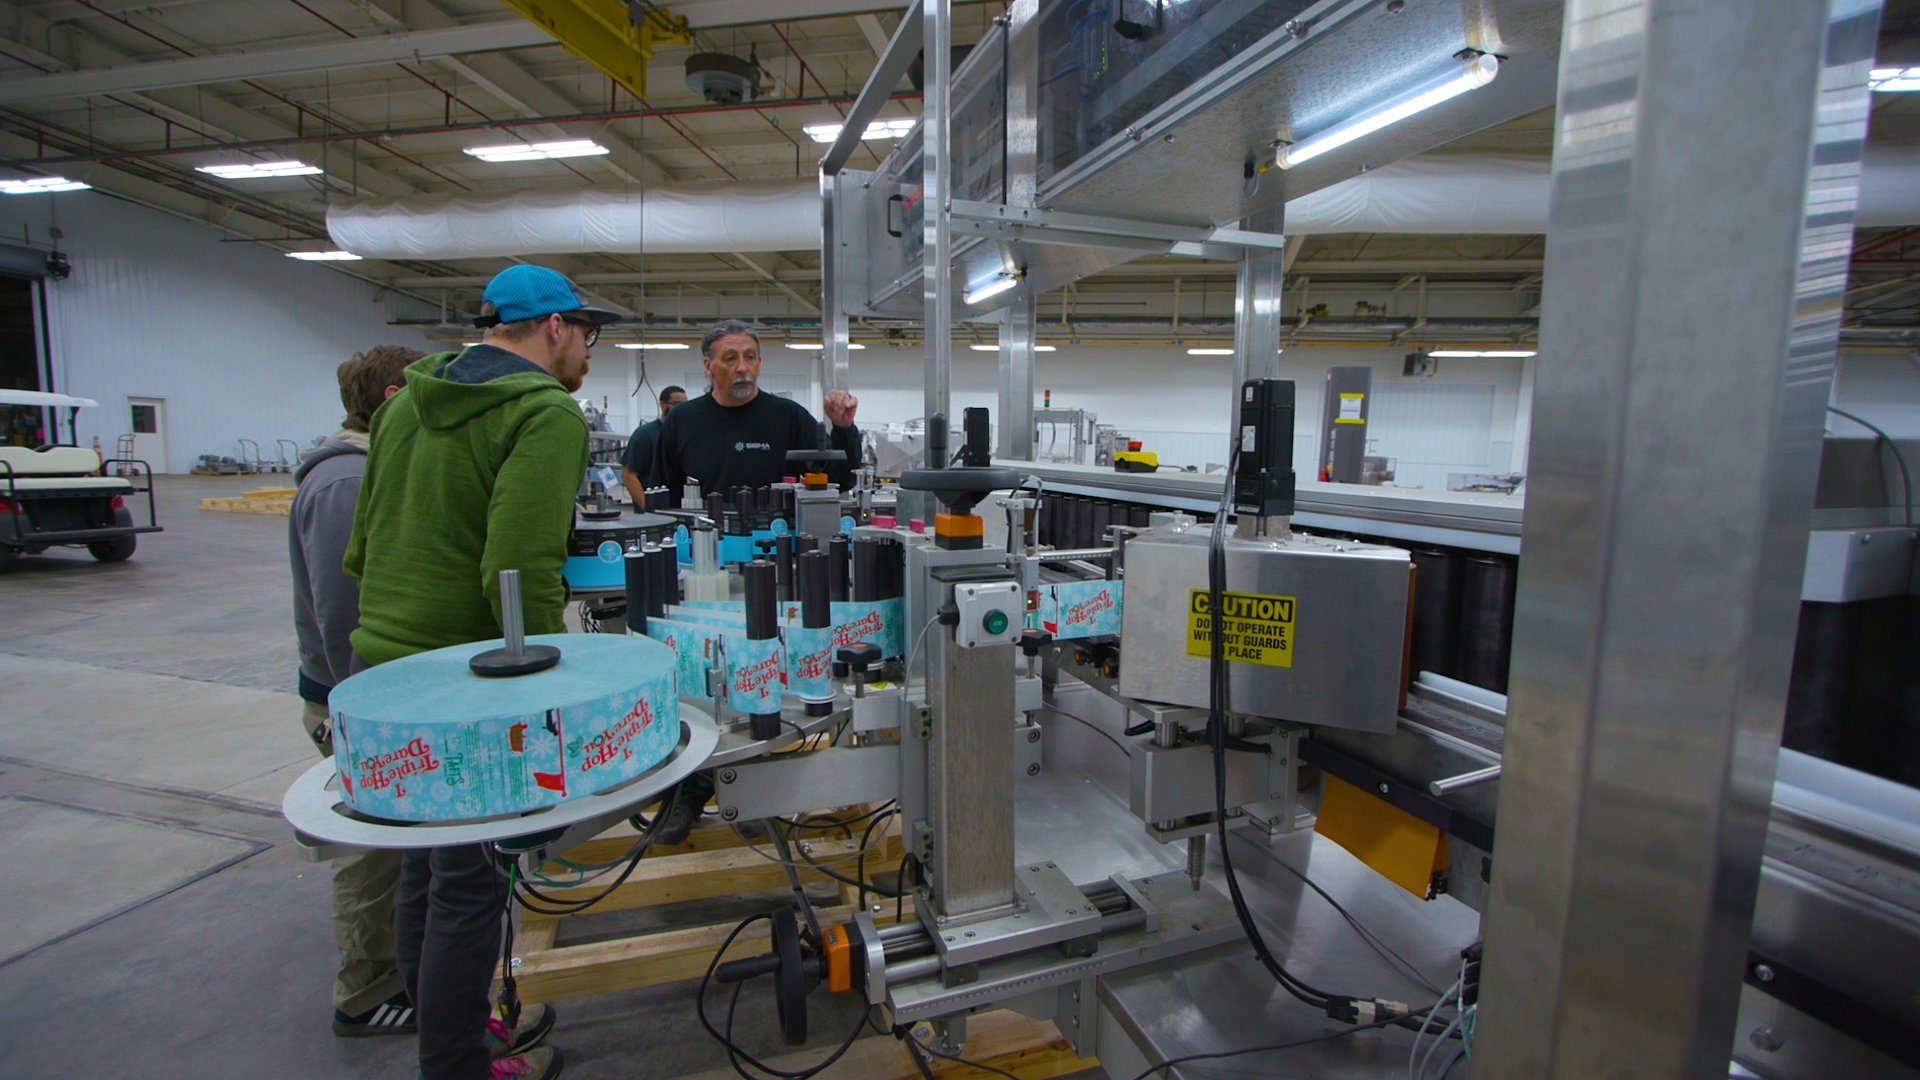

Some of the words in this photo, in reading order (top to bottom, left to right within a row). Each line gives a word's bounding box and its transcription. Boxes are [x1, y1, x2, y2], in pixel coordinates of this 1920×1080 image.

[1194, 593, 1290, 621] CUTION
[851, 610, 880, 628] Dare
[852, 618, 884, 640] Triple
[1196, 618, 1210, 629] DO
[1237, 621, 1285, 637] OPERATE
[1193, 630, 1242, 645] WITOUT
[1244, 635, 1287, 650] GUARDS
[1228, 646, 1262, 660] PLACE
[797, 662, 824, 680] Hop
[734, 676, 756, 692] Hop
[614, 697, 649, 733] Dare
[617, 711, 653, 747] Triple
[385, 737, 430, 763] Dare
[581, 743, 619, 772] Hop
[388, 754, 439, 780] Triple
[360, 771, 389, 790] Hop
